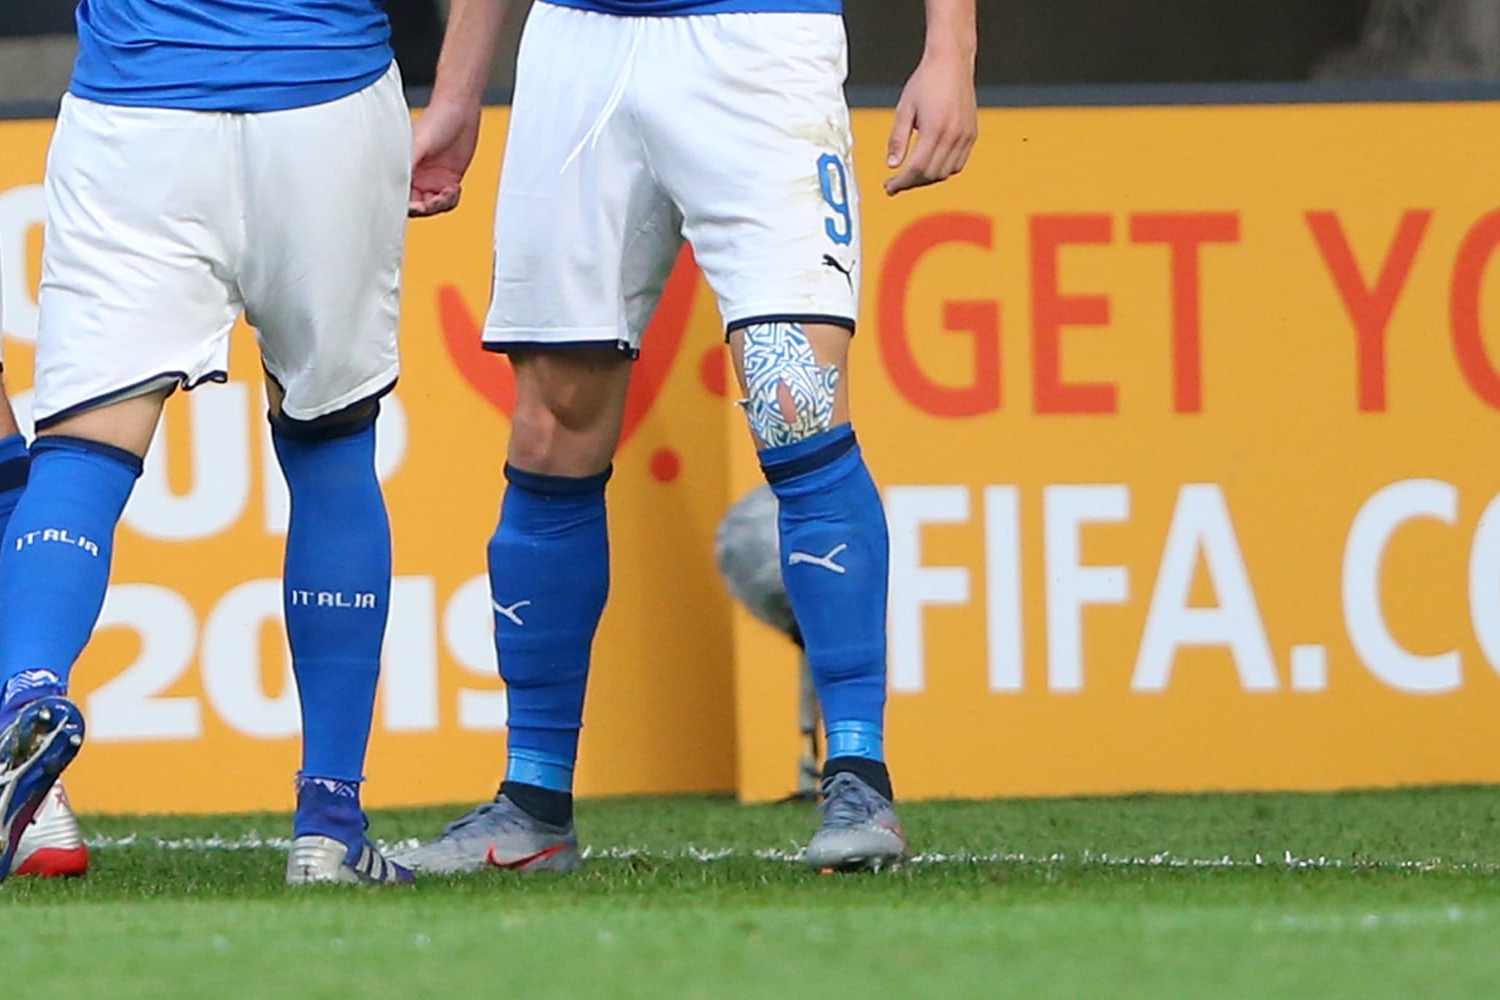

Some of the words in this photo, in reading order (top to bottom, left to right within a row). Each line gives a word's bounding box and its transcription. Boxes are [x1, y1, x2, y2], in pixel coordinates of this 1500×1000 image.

[816, 153, 853, 247] 9
[875, 209, 1241, 421] GET
[16, 528, 99, 557] ITALIA
[886, 478, 1500, 696] FIFA.C
[292, 590, 376, 609] ITALIA
